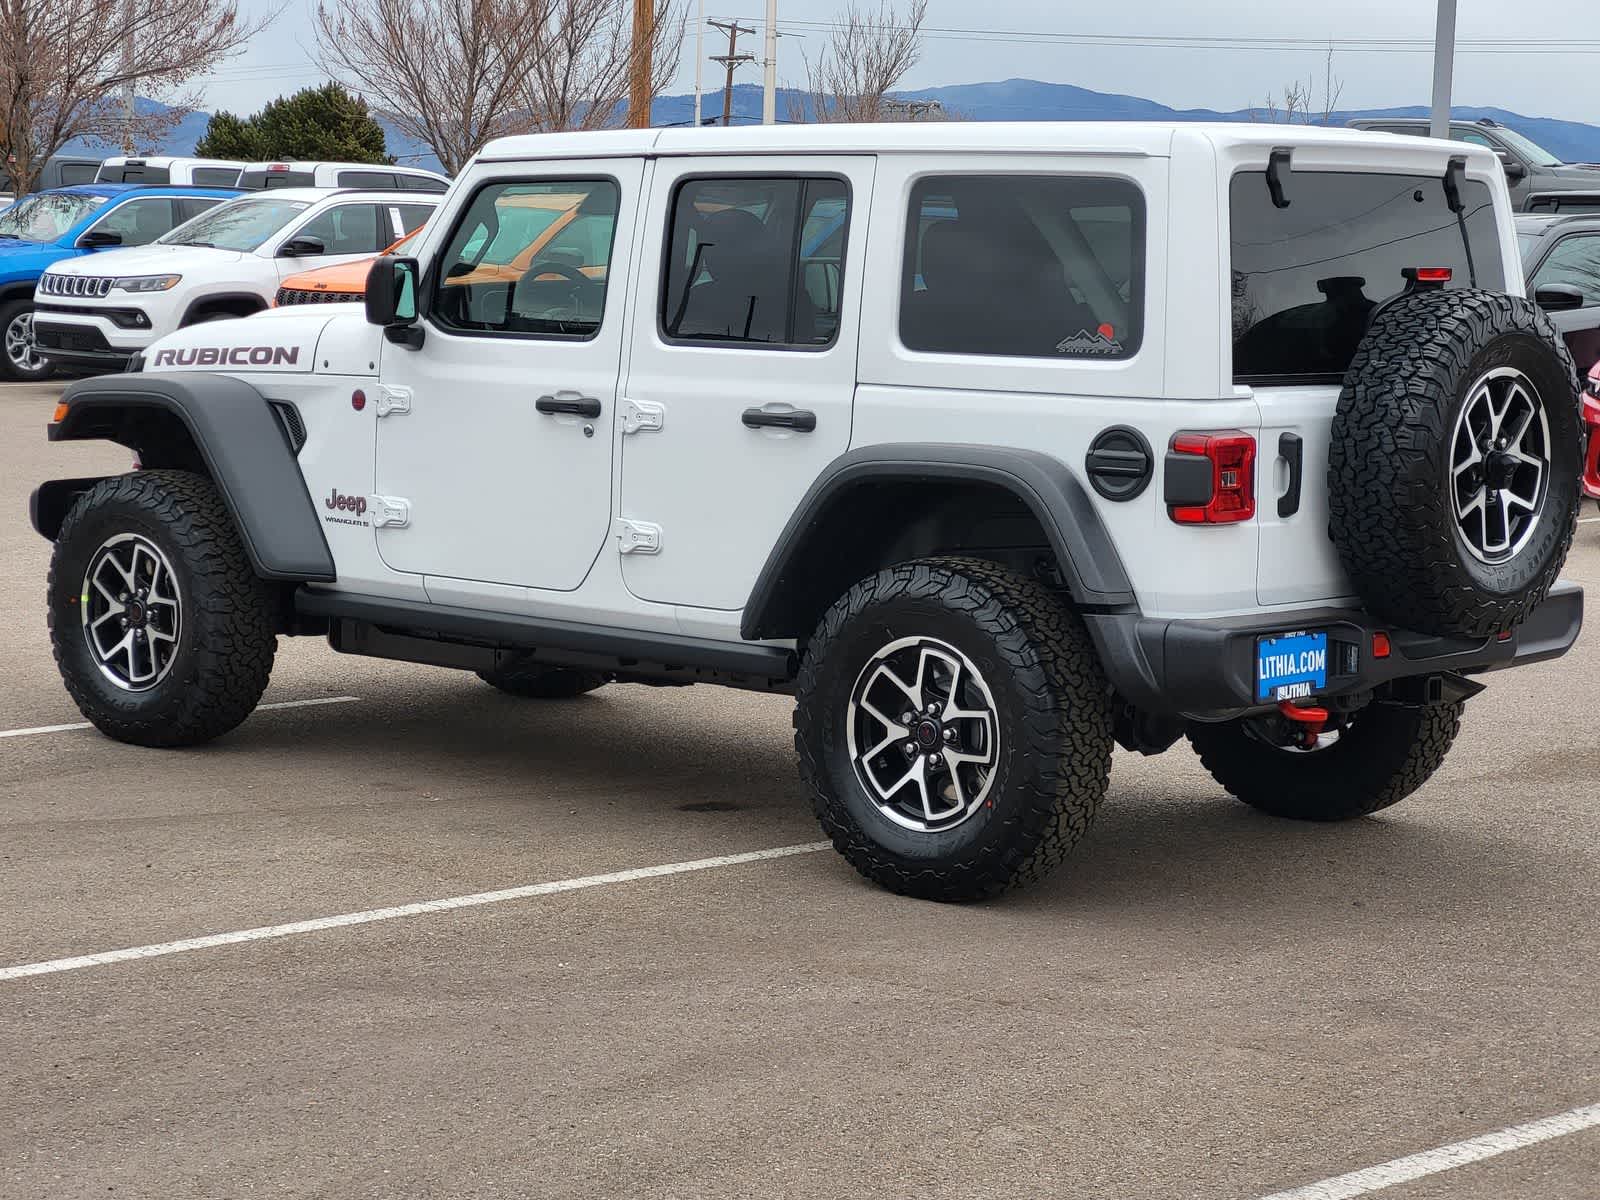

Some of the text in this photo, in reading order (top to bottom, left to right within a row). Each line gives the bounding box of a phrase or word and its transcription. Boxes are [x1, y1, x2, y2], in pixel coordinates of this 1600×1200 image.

[154, 346, 300, 366] RUBICON
[325, 488, 367, 517] Jeep
[325, 516, 363, 527] WRANGLER
[1260, 649, 1326, 680] LITHIA.COM
